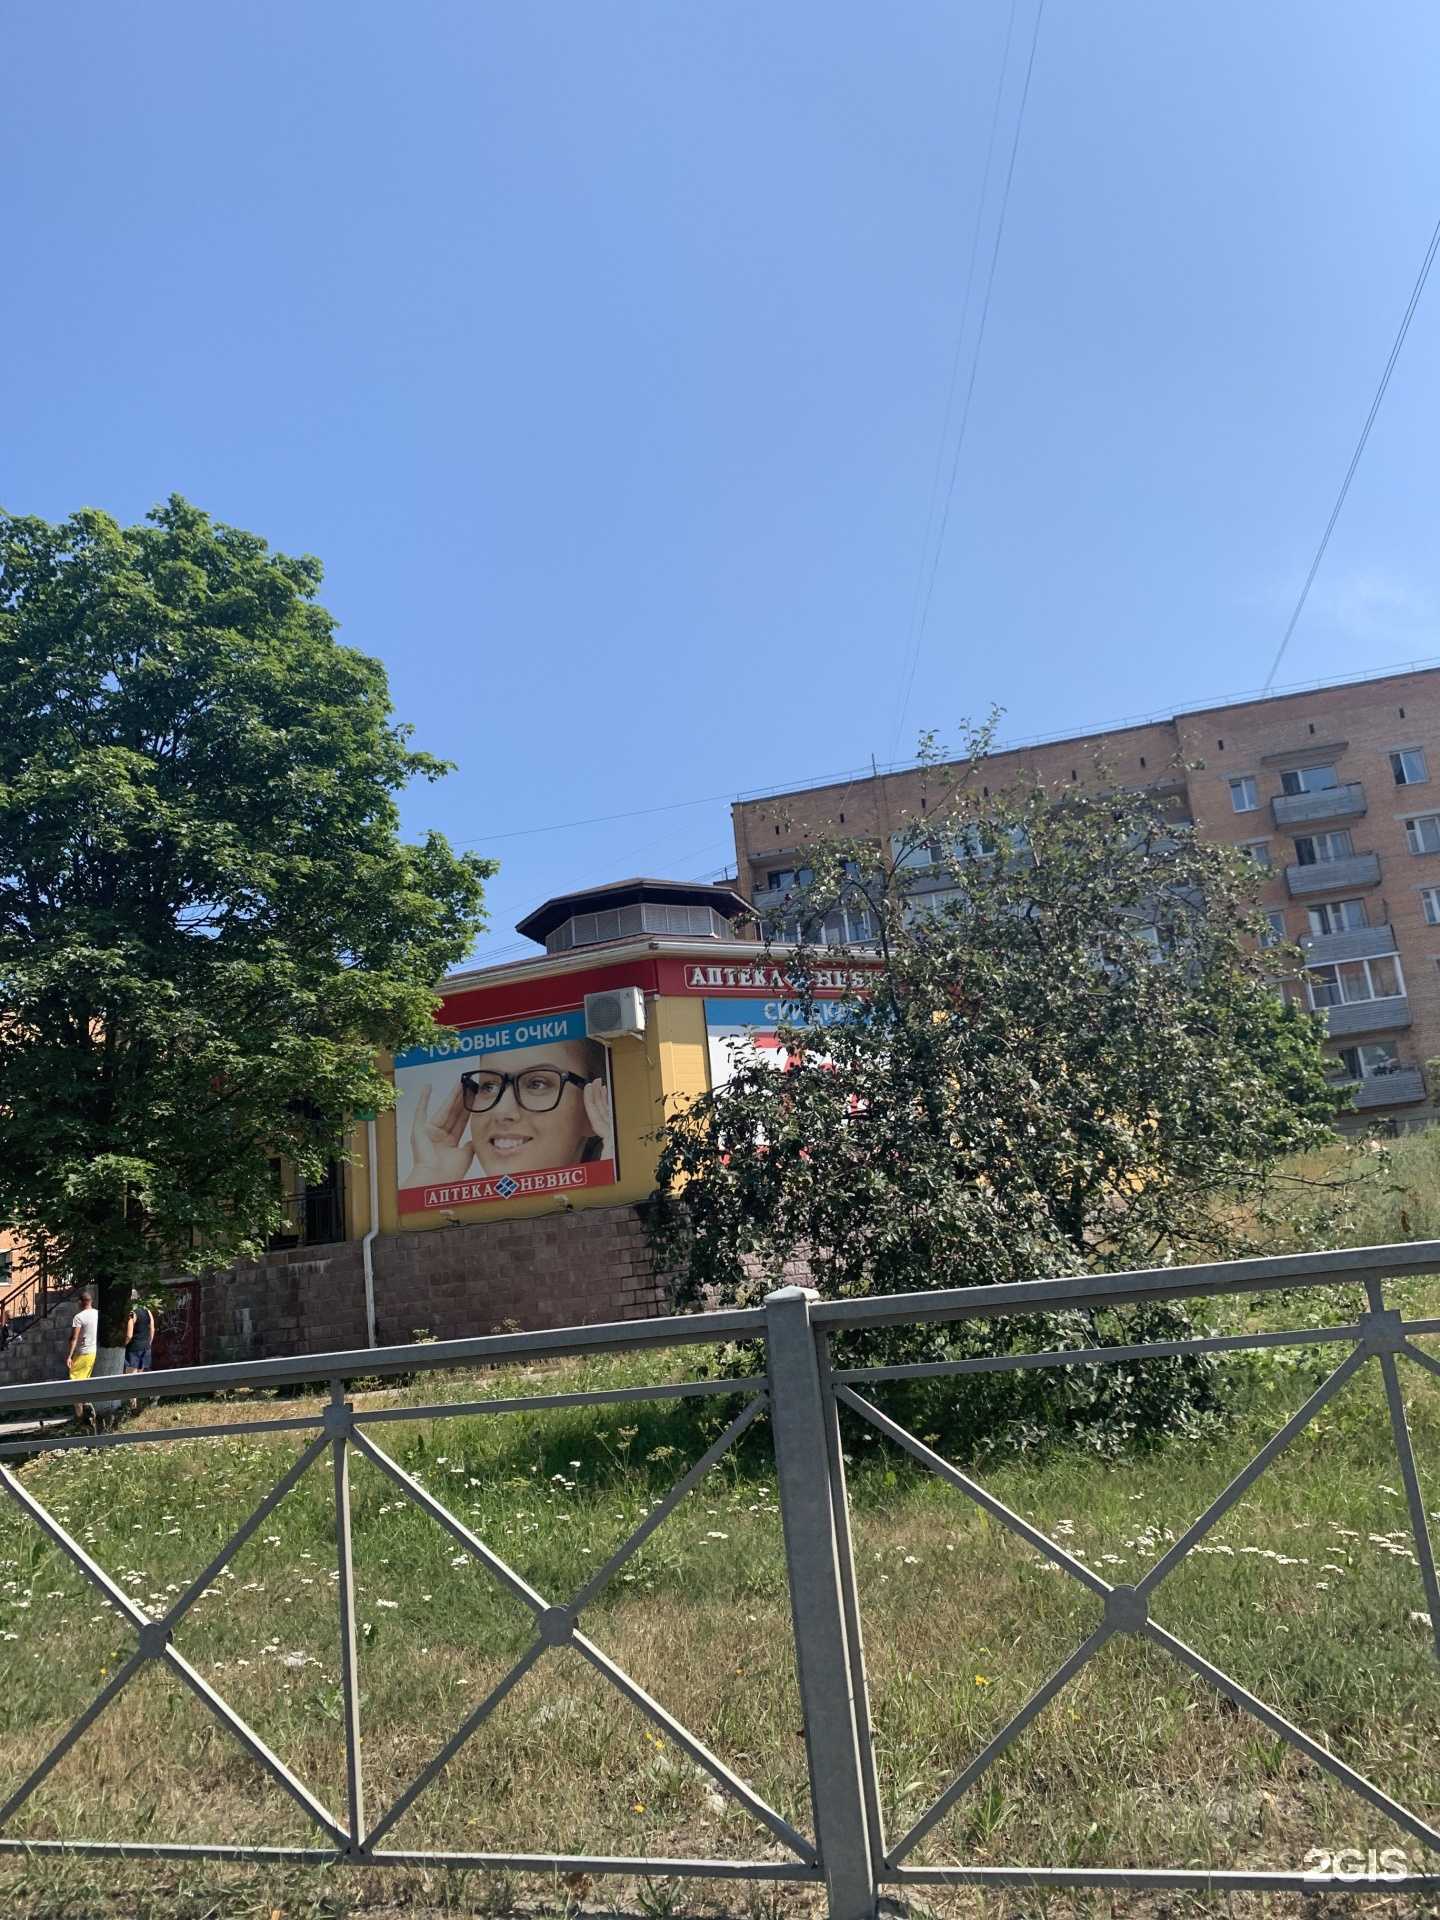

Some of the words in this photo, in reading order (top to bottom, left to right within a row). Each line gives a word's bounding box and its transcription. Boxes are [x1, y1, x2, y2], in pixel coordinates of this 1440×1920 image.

[691, 967, 785, 987] АПТЕКА
[515, 1020, 568, 1043] ОЧКИ
[427, 1183, 495, 1205] АПТЕКА
[519, 1169, 584, 1191] НЕВИС
